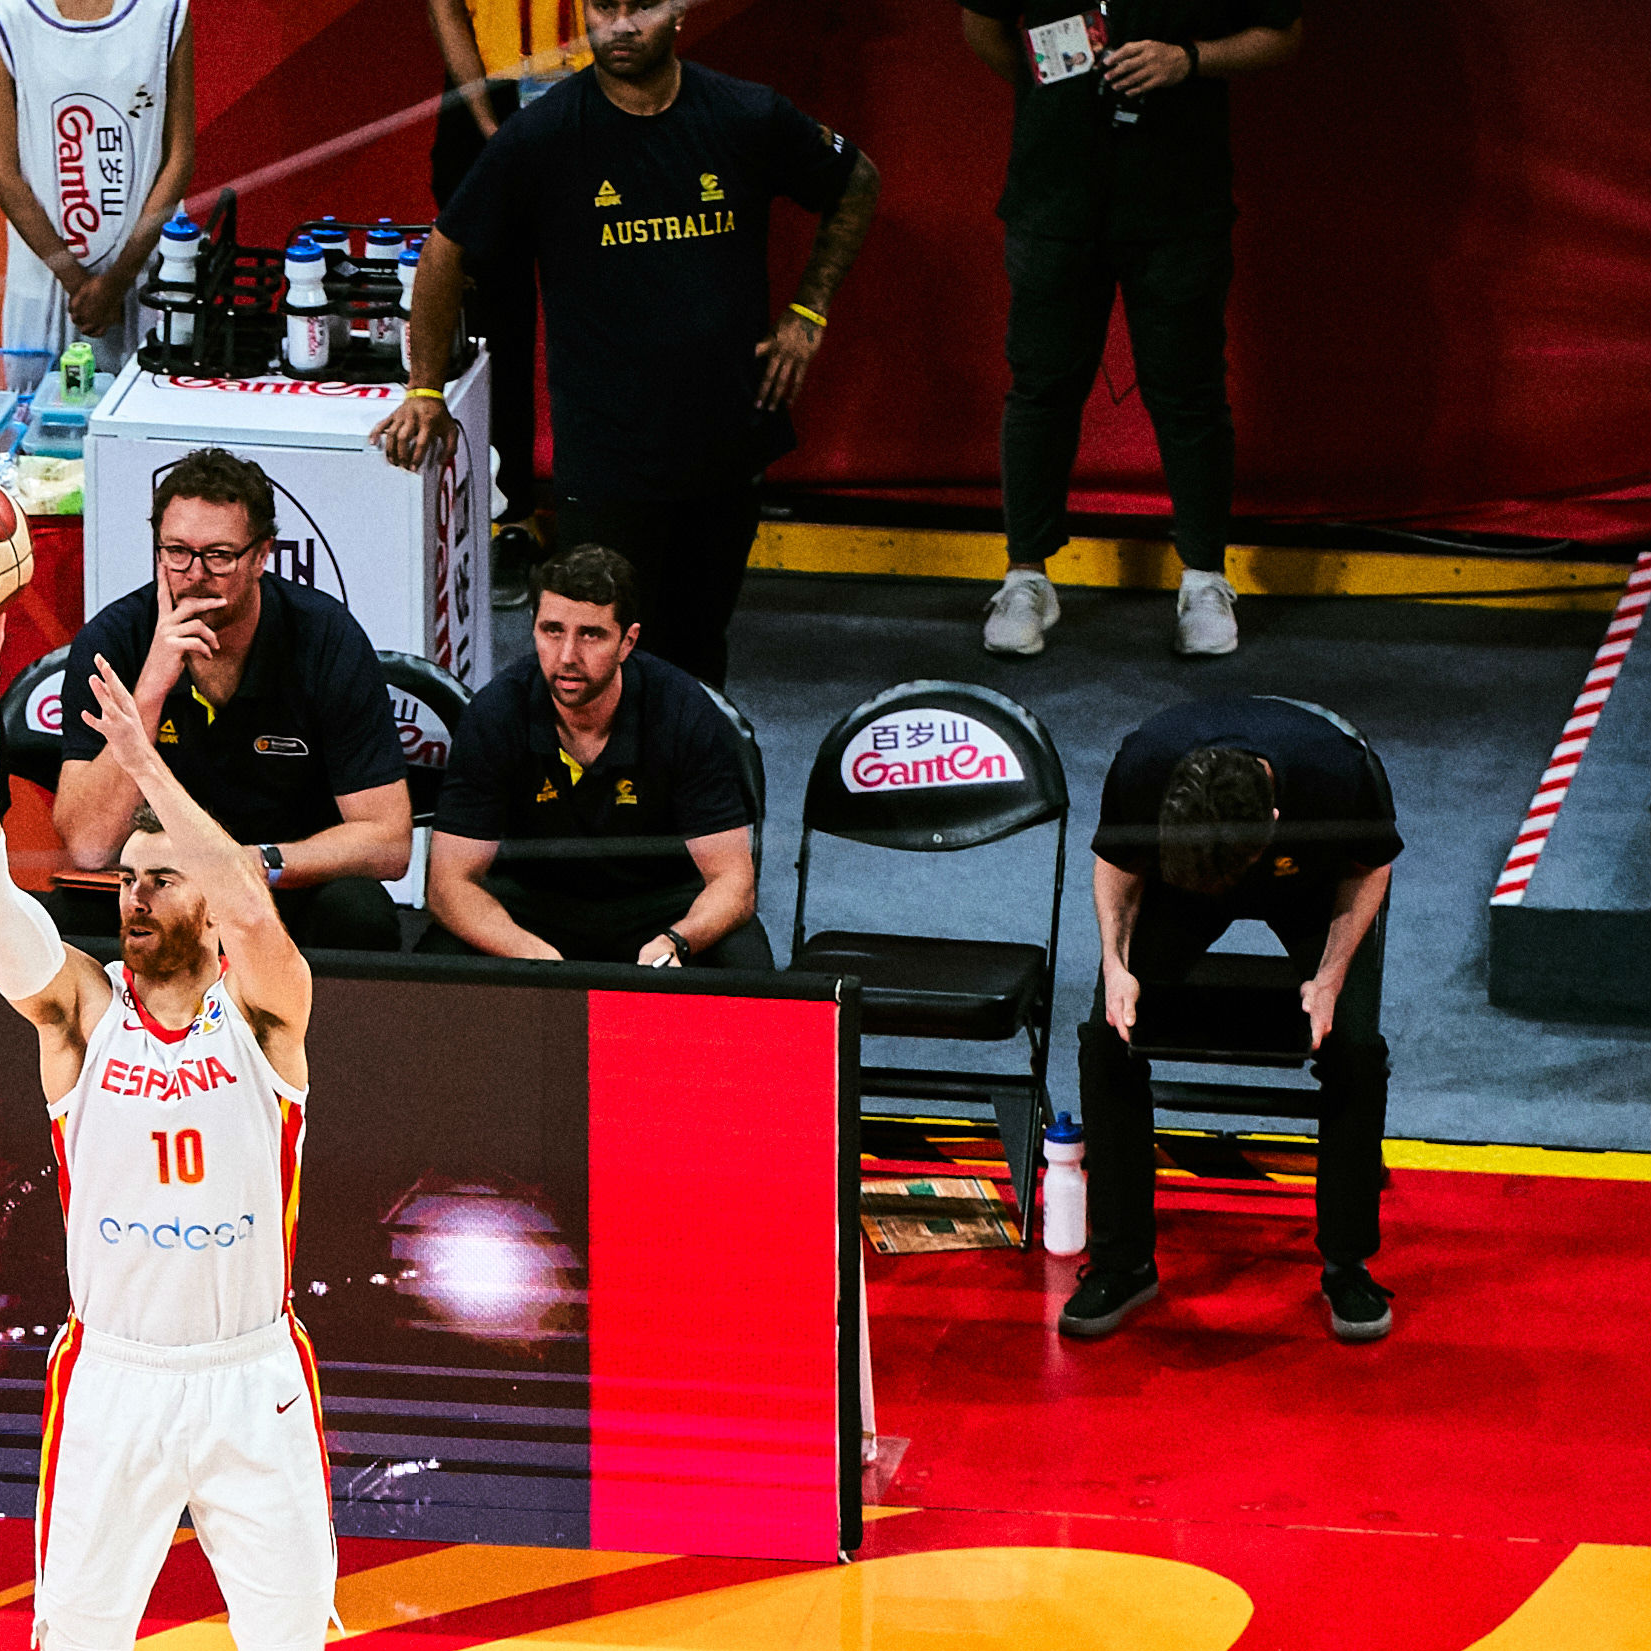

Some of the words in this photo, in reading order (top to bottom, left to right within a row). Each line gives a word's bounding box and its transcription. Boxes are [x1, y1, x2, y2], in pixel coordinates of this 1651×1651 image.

[97, 126, 124, 216] 百岁山
[601, 210, 735, 247] AUSTRALIA
[871, 720, 969, 751] 百岁山
[101, 1056, 237, 1102] ESPAÑA
[150, 1128, 206, 1186] 10
[98, 1213, 255, 1251] endesa
